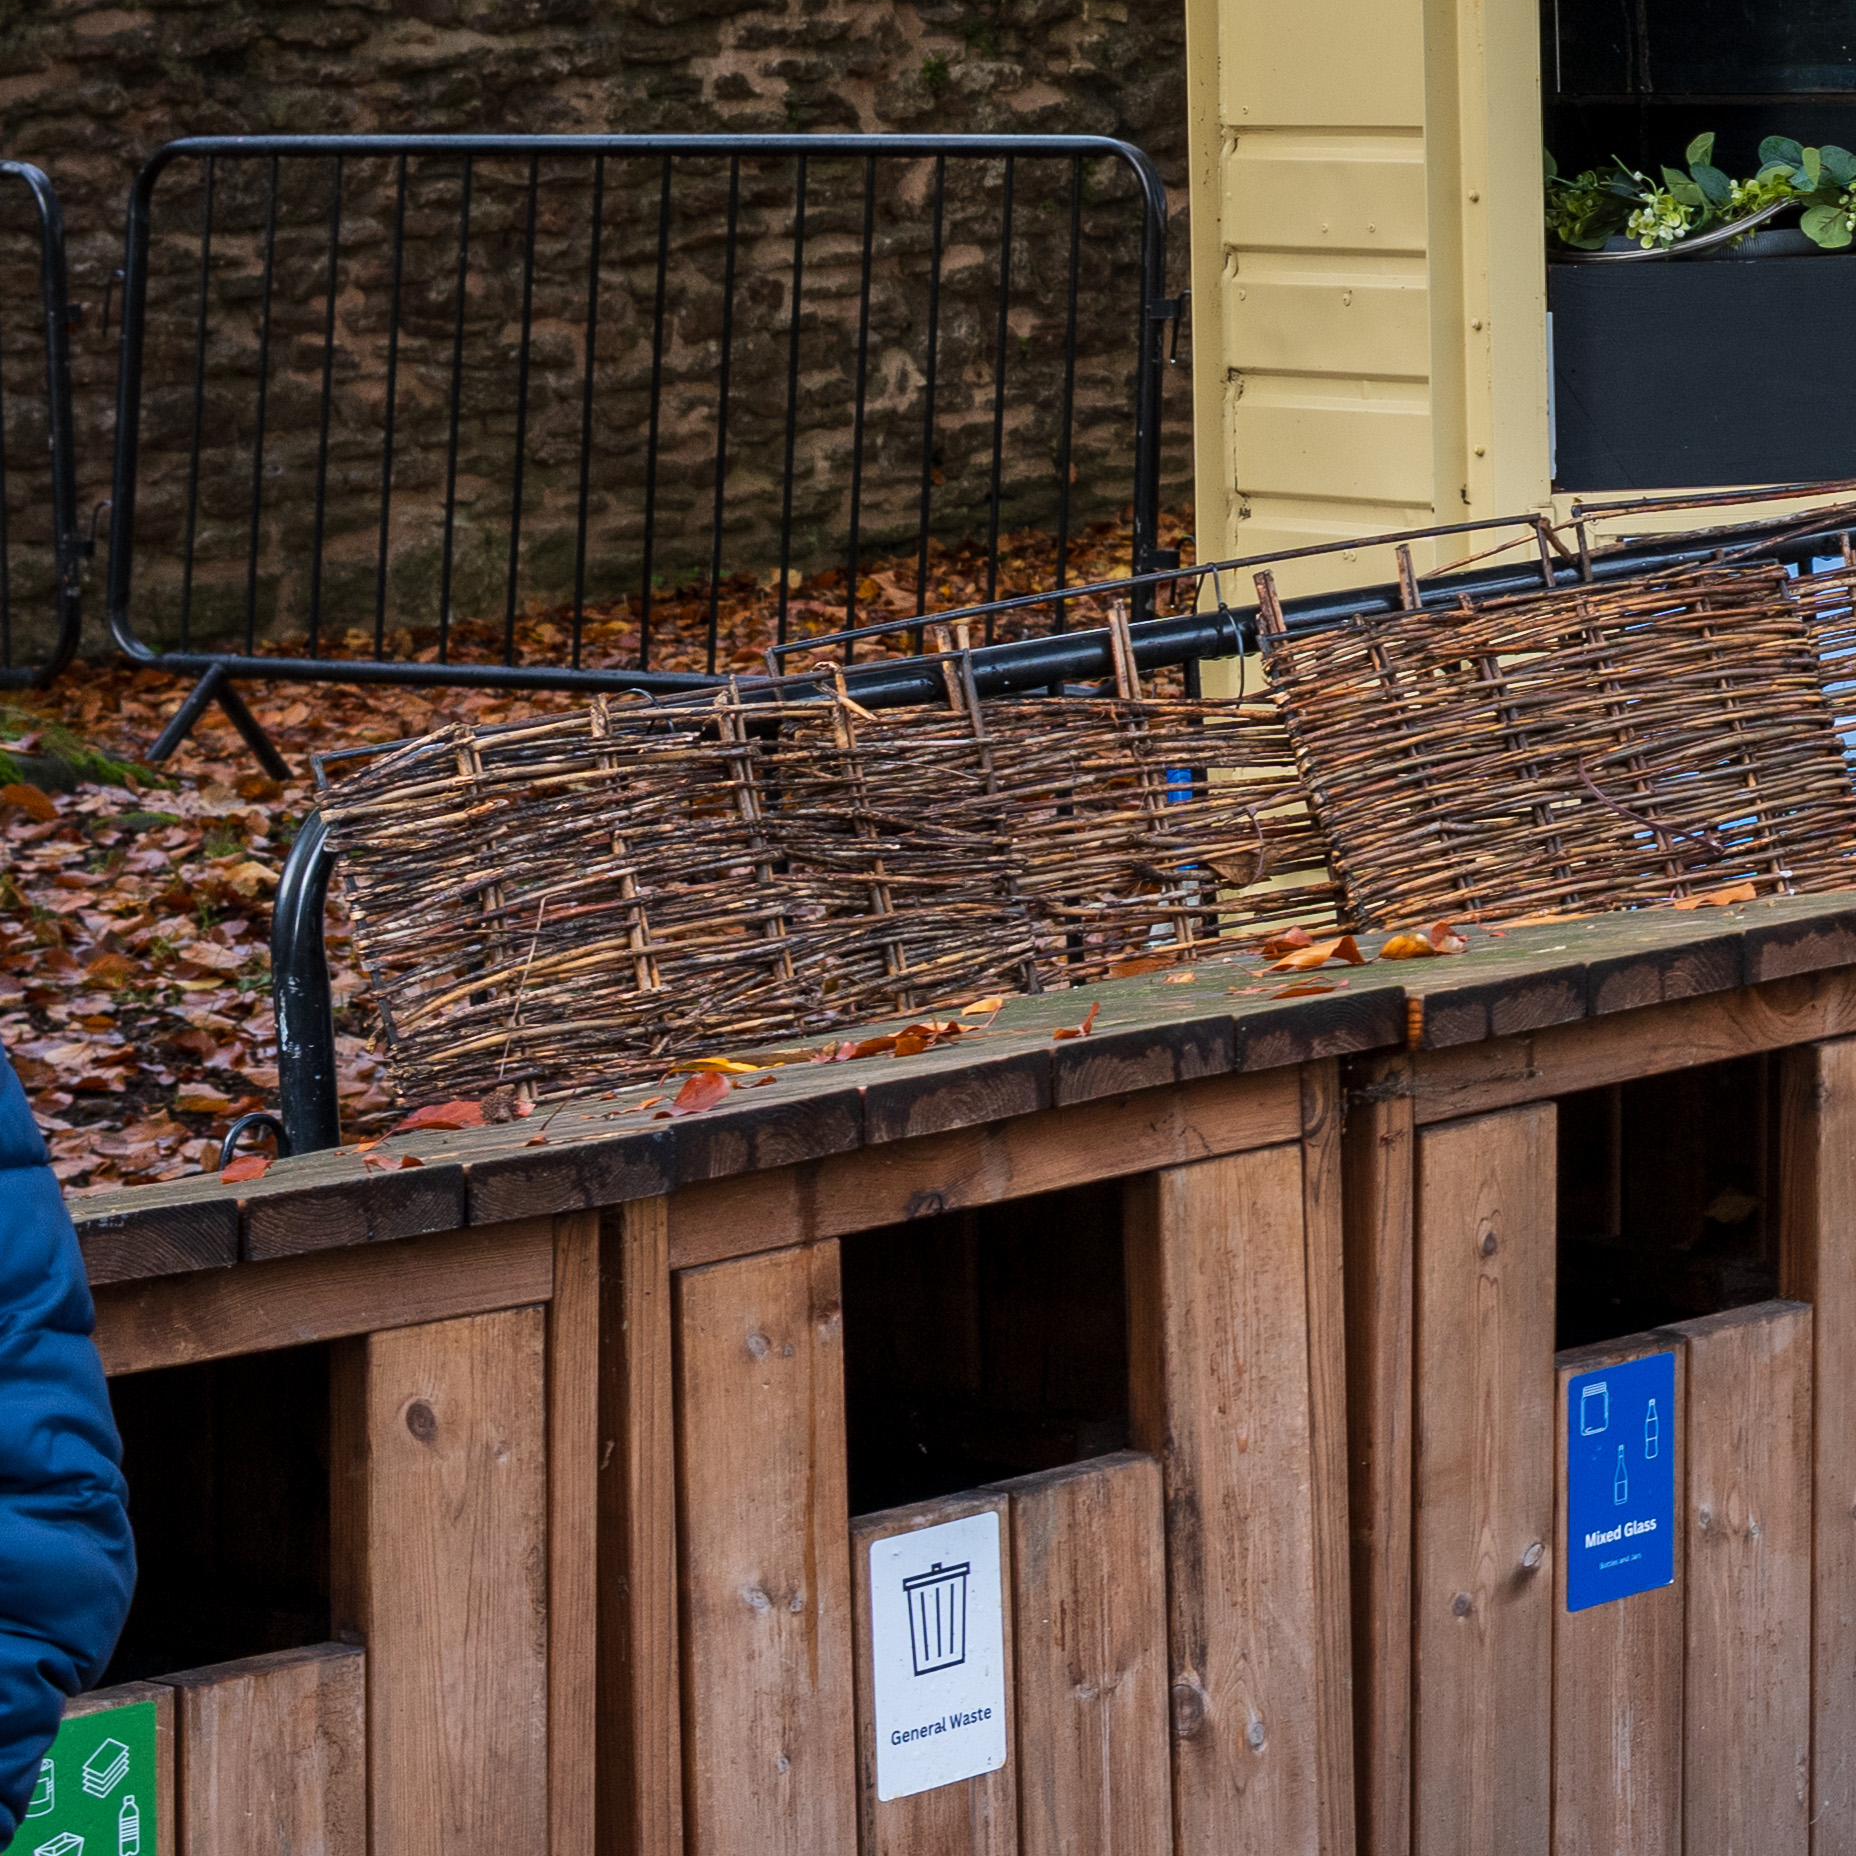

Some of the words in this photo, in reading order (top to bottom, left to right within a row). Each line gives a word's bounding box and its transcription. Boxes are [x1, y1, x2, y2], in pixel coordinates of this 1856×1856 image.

[1585, 1524, 1622, 1549] Mixed
[1624, 1518, 1657, 1537] Glass
[891, 1717, 947, 1745] General
[949, 1707, 992, 1729] Waste
